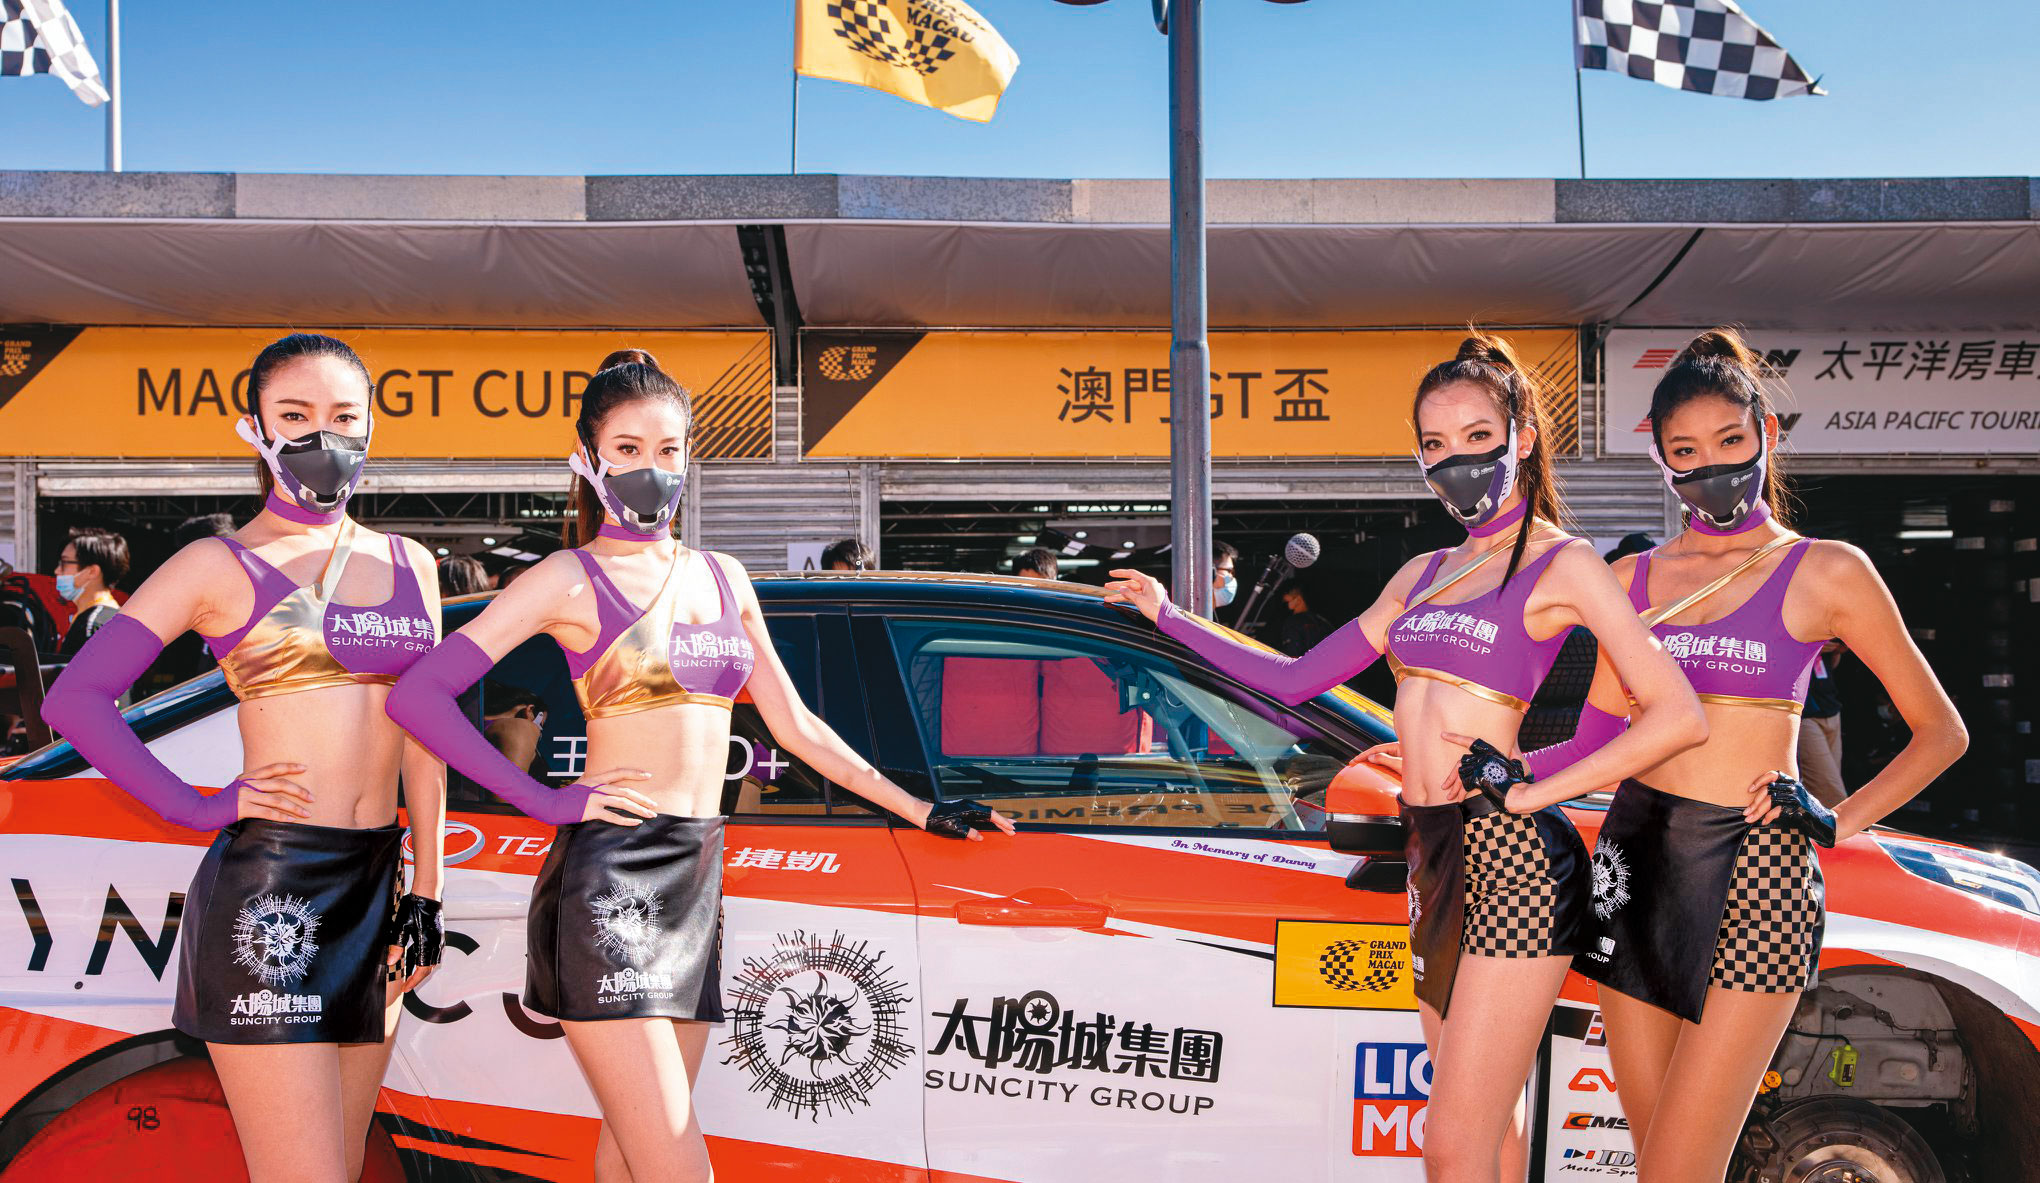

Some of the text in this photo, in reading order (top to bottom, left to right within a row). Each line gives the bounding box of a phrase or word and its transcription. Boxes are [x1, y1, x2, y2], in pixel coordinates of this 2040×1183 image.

[907, 7, 975, 42] MACAU
[1815, 340, 2040, 381] 太平洋房車
[376, 369, 453, 418] GT
[1825, 411, 2040, 430] ASIA PACIFC TOURI
[327, 611, 435, 640] 太陽城集
[1398, 610, 1499, 644] 太陽城集團
[332, 637, 432, 654] SUNCITY GRO
[669, 631, 754, 660] 太陽城集
[1394, 633, 1491, 655] SUNCITY GROUP
[673, 659, 753, 674] SUNCITY GRO
[1705, 660, 1766, 676] GROUP
[724, 846, 841, 874] 捷凱
[1171, 839, 1317, 870] In Memory of Danny
[1368, 950, 1394, 959] PRIX
[1369, 940, 1407, 950] GRAND
[1368, 960, 1405, 970] MACAU
[230, 989, 322, 1016] 太陽城集團
[598, 991, 674, 1004] SUNCITY GROUP
[230, 1015, 322, 1026] SUNCITY GROUP
[927, 990, 1224, 1083] 太陽城集團
[924, 1069, 1215, 1116] SUNCITY GROUP
[127, 1106, 161, 1130] 98
[1559, 1163, 1639, 1177] Motor Spo
